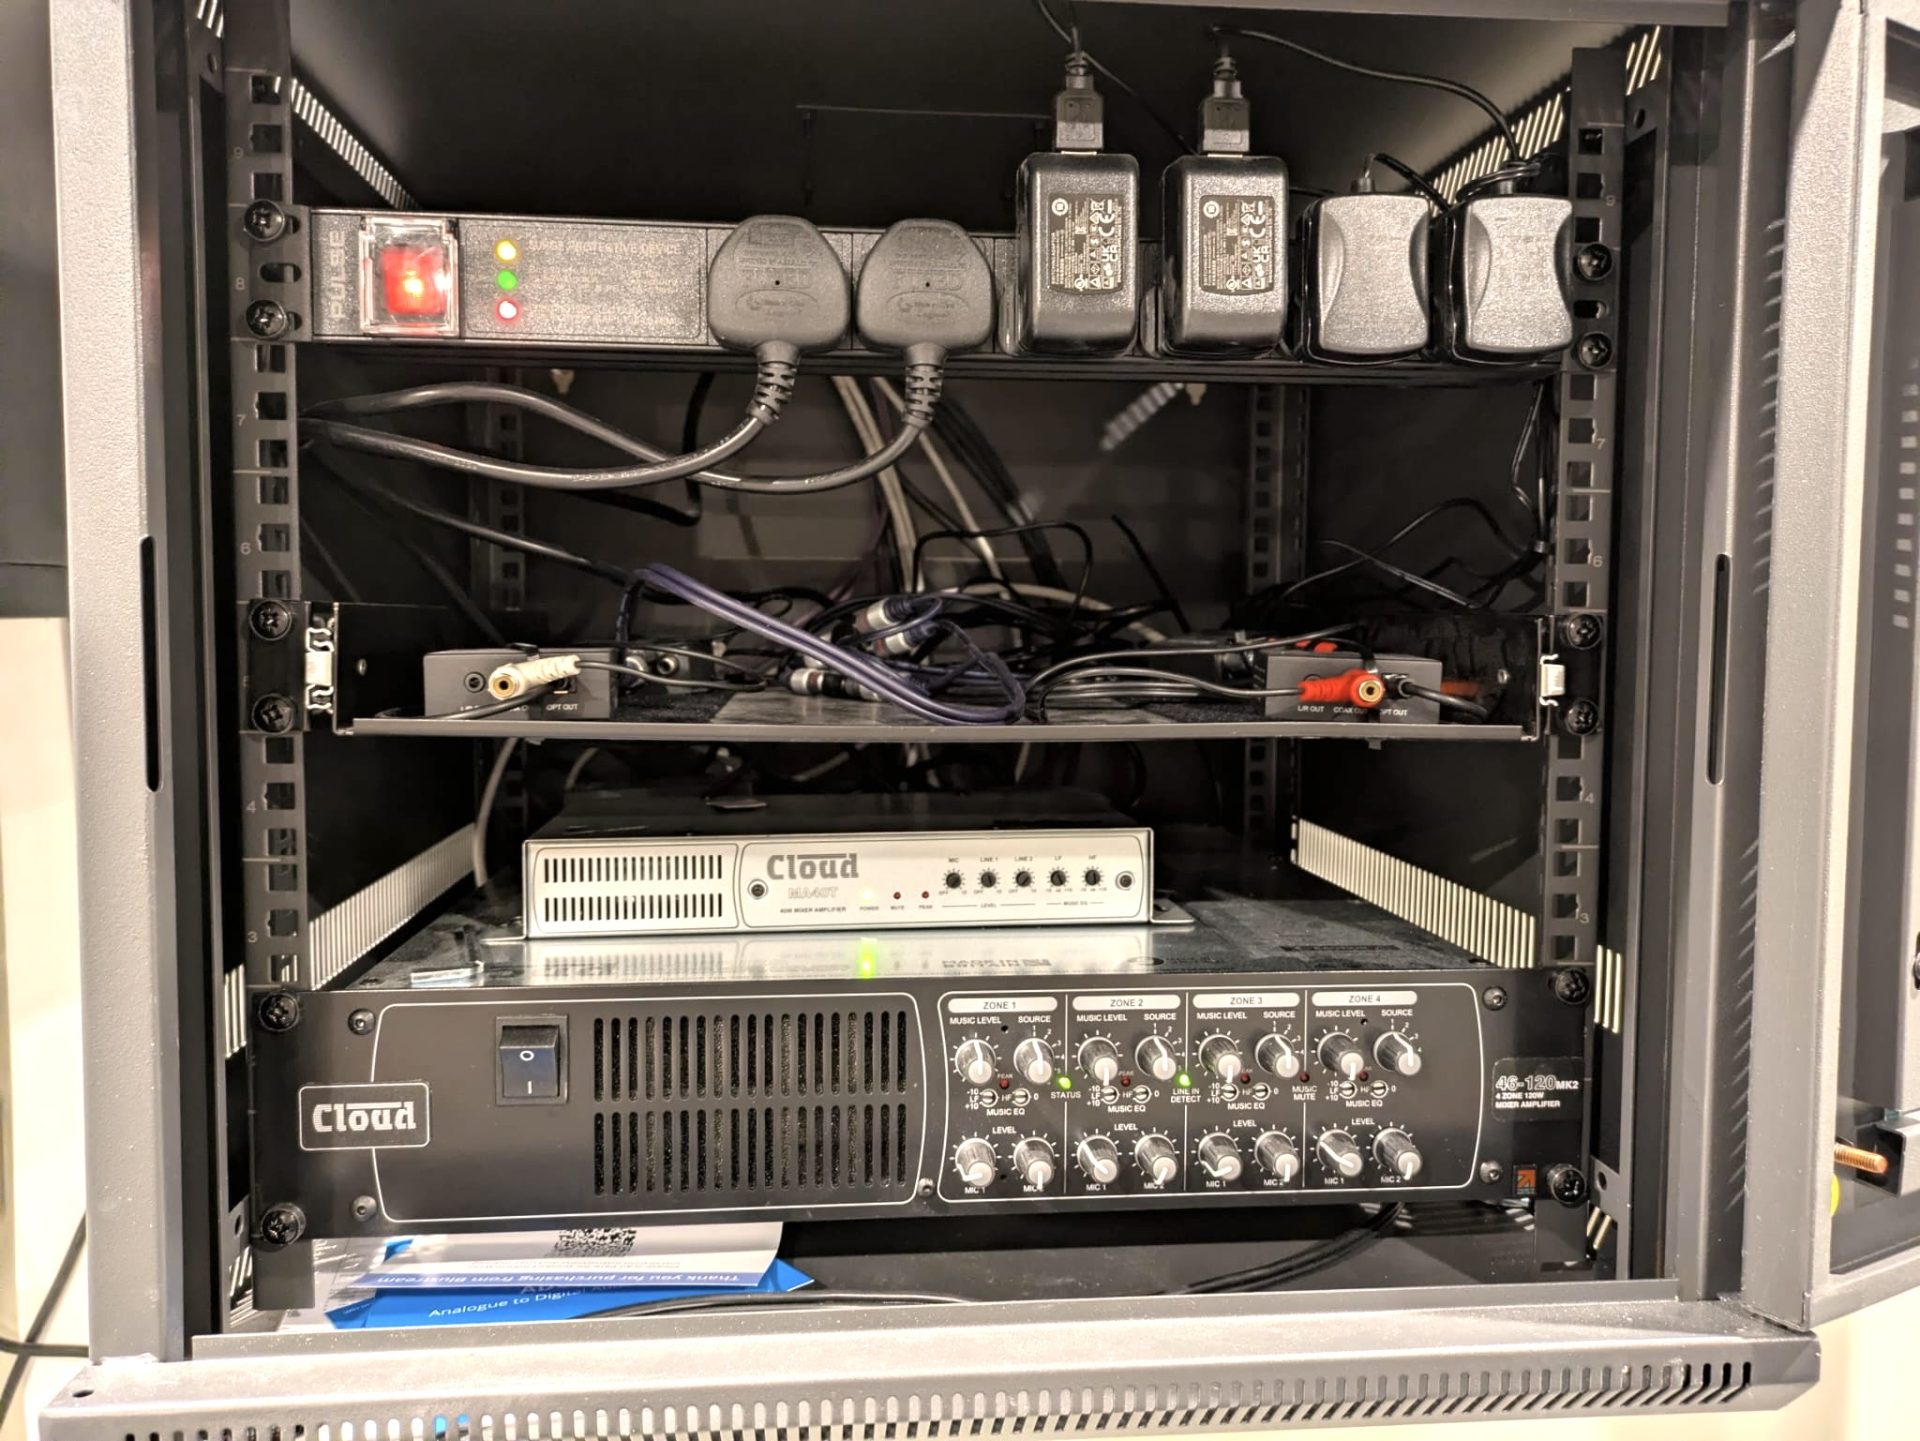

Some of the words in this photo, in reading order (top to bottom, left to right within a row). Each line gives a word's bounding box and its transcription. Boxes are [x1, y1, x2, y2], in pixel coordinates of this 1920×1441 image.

[329, 231, 346, 319] PULSE
[546, 703, 561, 711] OPT
[562, 703, 578, 711] OUT
[766, 852, 859, 880] Cloud
[1110, 999, 1135, 1007] ZONE
[1138, 999, 1143, 1007] 2
[1230, 997, 1255, 1005] ZONE
[1348, 995, 1373, 1003] ZONE
[983, 1001, 1008, 1010] ZONE
[1012, 1001, 1016, 1009] 1
[1144, 1013, 1176, 1021] SOURCE
[1196, 1012, 1221, 1020] MUSIC
[1223, 1011, 1247, 1019] LEVEL
[1263, 1010, 1296, 1019] SOURCE
[1315, 1010, 1340, 1018] MUSIC
[1341, 1009, 1366, 1017] LEVEL
[1381, 1009, 1413, 1017] SOURCE
[949, 1016, 976, 1025] MUSIC
[976, 1016, 1002, 1024] LEVEL
[1018, 1015, 1051, 1023] SOURCE
[1076, 1014, 1102, 1022] MUSIC
[1103, 1013, 1128, 1021] LEVEL
[970, 1095, 979, 1103] LF
[1050, 1091, 1081, 1099] STATUS
[1091, 1092, 1100, 1100] LF
[1170, 1095, 1201, 1103] DETECT
[1294, 1093, 1316, 1101] MUTE
[1227, 1102, 1252, 1110] MUSIC
[1253, 1102, 1266, 1110] EQ
[1371, 1099, 1383, 1107] EQ
[1520, 1100, 1560, 1108] AMPLIFIER
[986, 1108, 1012, 1116] MUSIC
[1013, 1108, 1026, 1116] EQ
[1107, 1105, 1133, 1113] MUSIC
[312, 1101, 416, 1132] Cloud
[1233, 1119, 1257, 1127] LEVEL
[1351, 1118, 1375, 1126] LEVEL
[992, 1126, 1017, 1134] LEVEL
[1114, 1123, 1138, 1131] LEVEL
[1206, 1180, 1221, 1188] MIC
[1264, 1179, 1278, 1187] MIC
[1324, 1177, 1339, 1185] MIC
[1381, 1176, 1395, 1184] MIC
[964, 1186, 979, 1194] MIC
[1086, 1183, 1101, 1191] MIC
[518, 1274, 616, 1284] purchasing
[619, 1273, 645, 1282] for
[650, 1273, 684, 1282] you
[686, 1273, 740, 1282] Thank
[428, 1299, 508, 1317] Analogue
[513, 1296, 530, 1305] to
